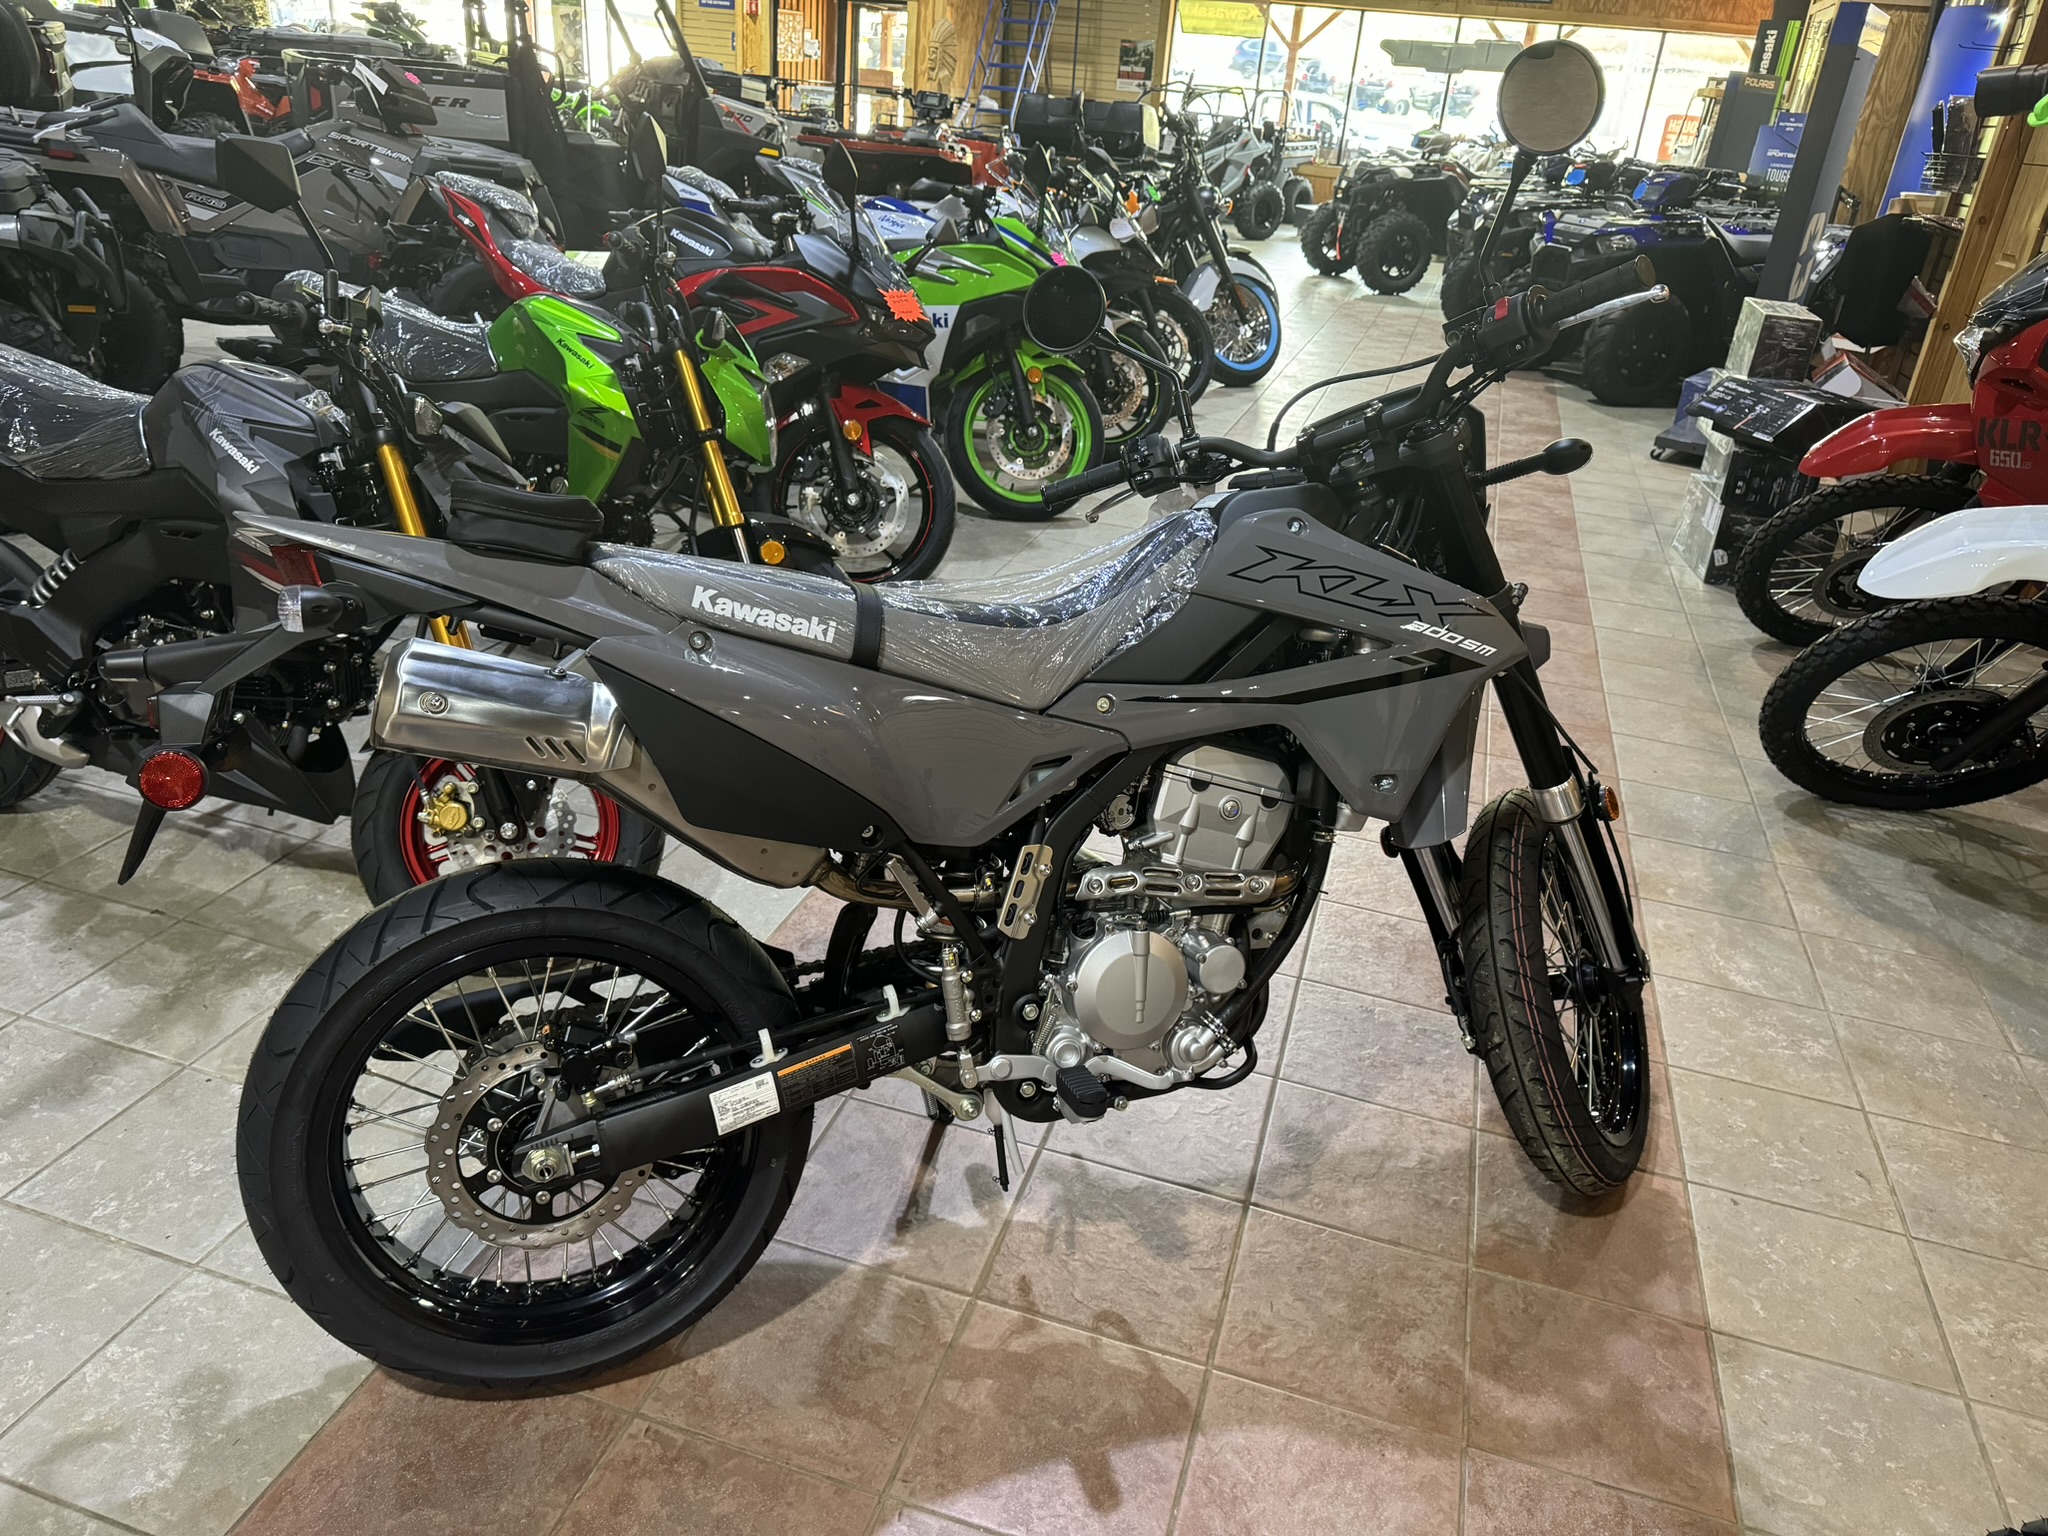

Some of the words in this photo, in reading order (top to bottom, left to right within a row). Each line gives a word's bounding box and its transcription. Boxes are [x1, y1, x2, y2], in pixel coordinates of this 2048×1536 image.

[1744, 77, 1776, 90] POLARIS
[327, 131, 414, 164] SPORTSMAN
[669, 228, 715, 257] Kawasaki
[556, 338, 596, 370] Kawasaki
[1978, 416, 2042, 452] KLR
[208, 427, 261, 475] Kawasaki
[1990, 449, 2021, 469] 650
[1227, 545, 1497, 628] KLX
[691, 584, 837, 644] Kawasaki
